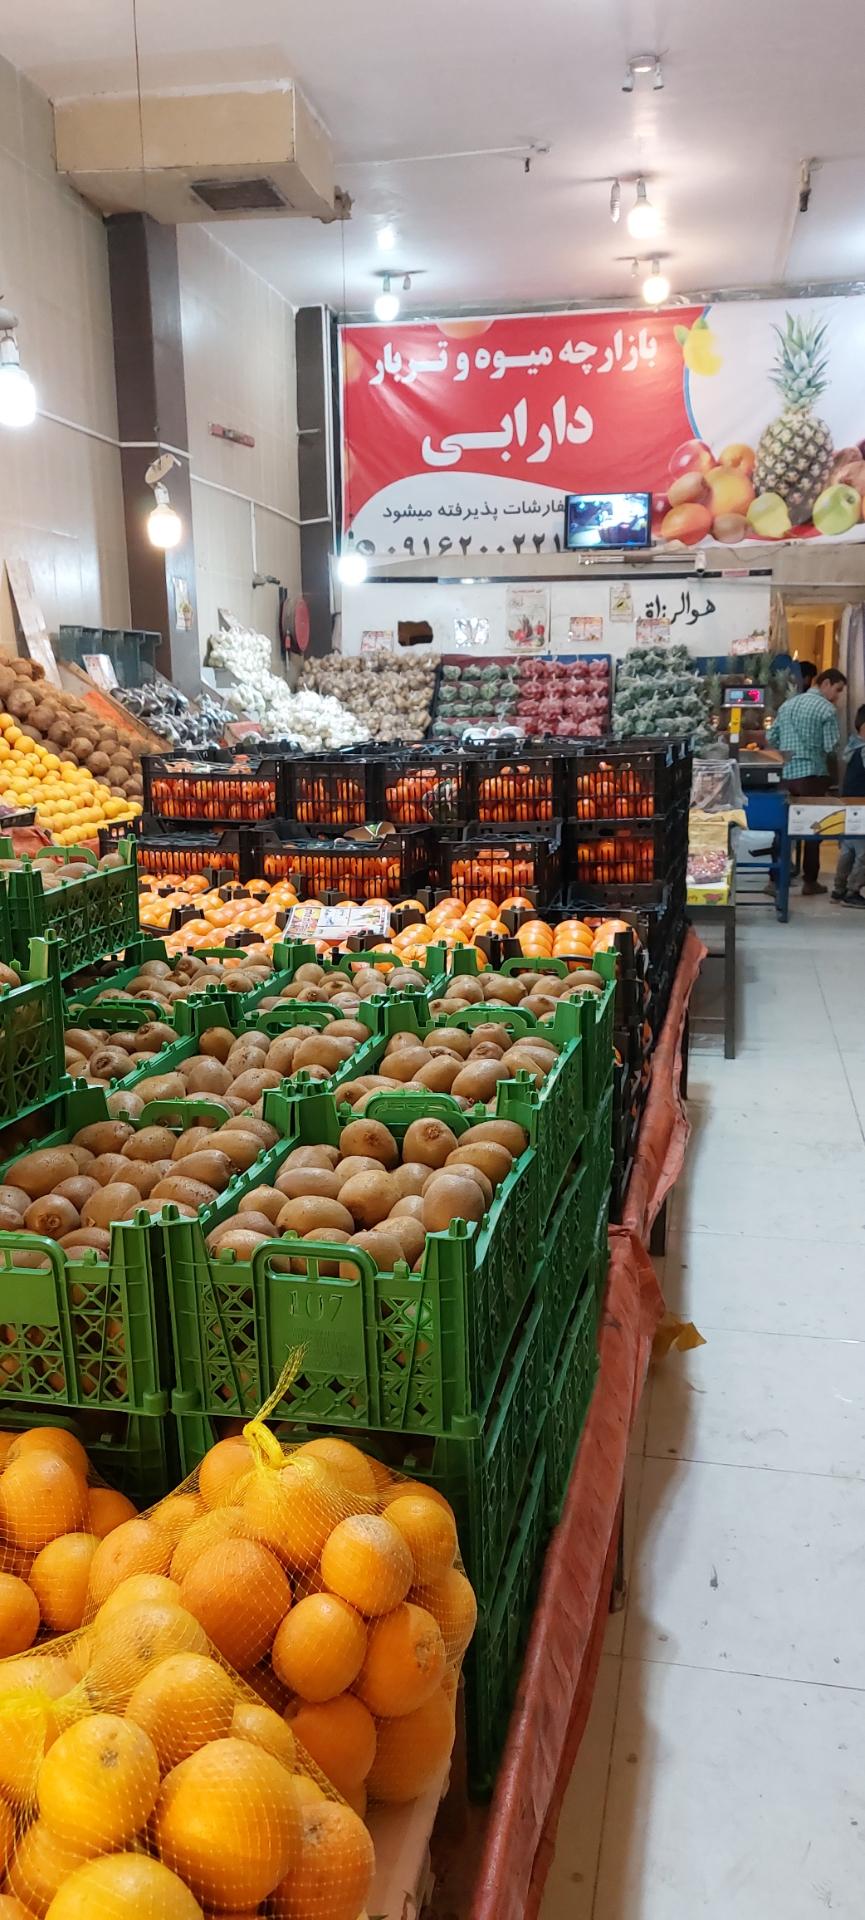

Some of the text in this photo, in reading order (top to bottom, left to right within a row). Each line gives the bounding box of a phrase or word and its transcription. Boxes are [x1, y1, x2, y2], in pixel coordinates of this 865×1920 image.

[452, 351, 470, 381] و
[474, 347, 553, 380] میوه
[558, 327, 658, 375] بازارچه
[421, 395, 594, 467] دارابی
[382, 499, 566, 524] فارشات پذیرفته میشود
[386, 533, 564, 556] ۰۹۱۶۲۰۰۲۲۱
[288, 1290, 344, 1322] 107
